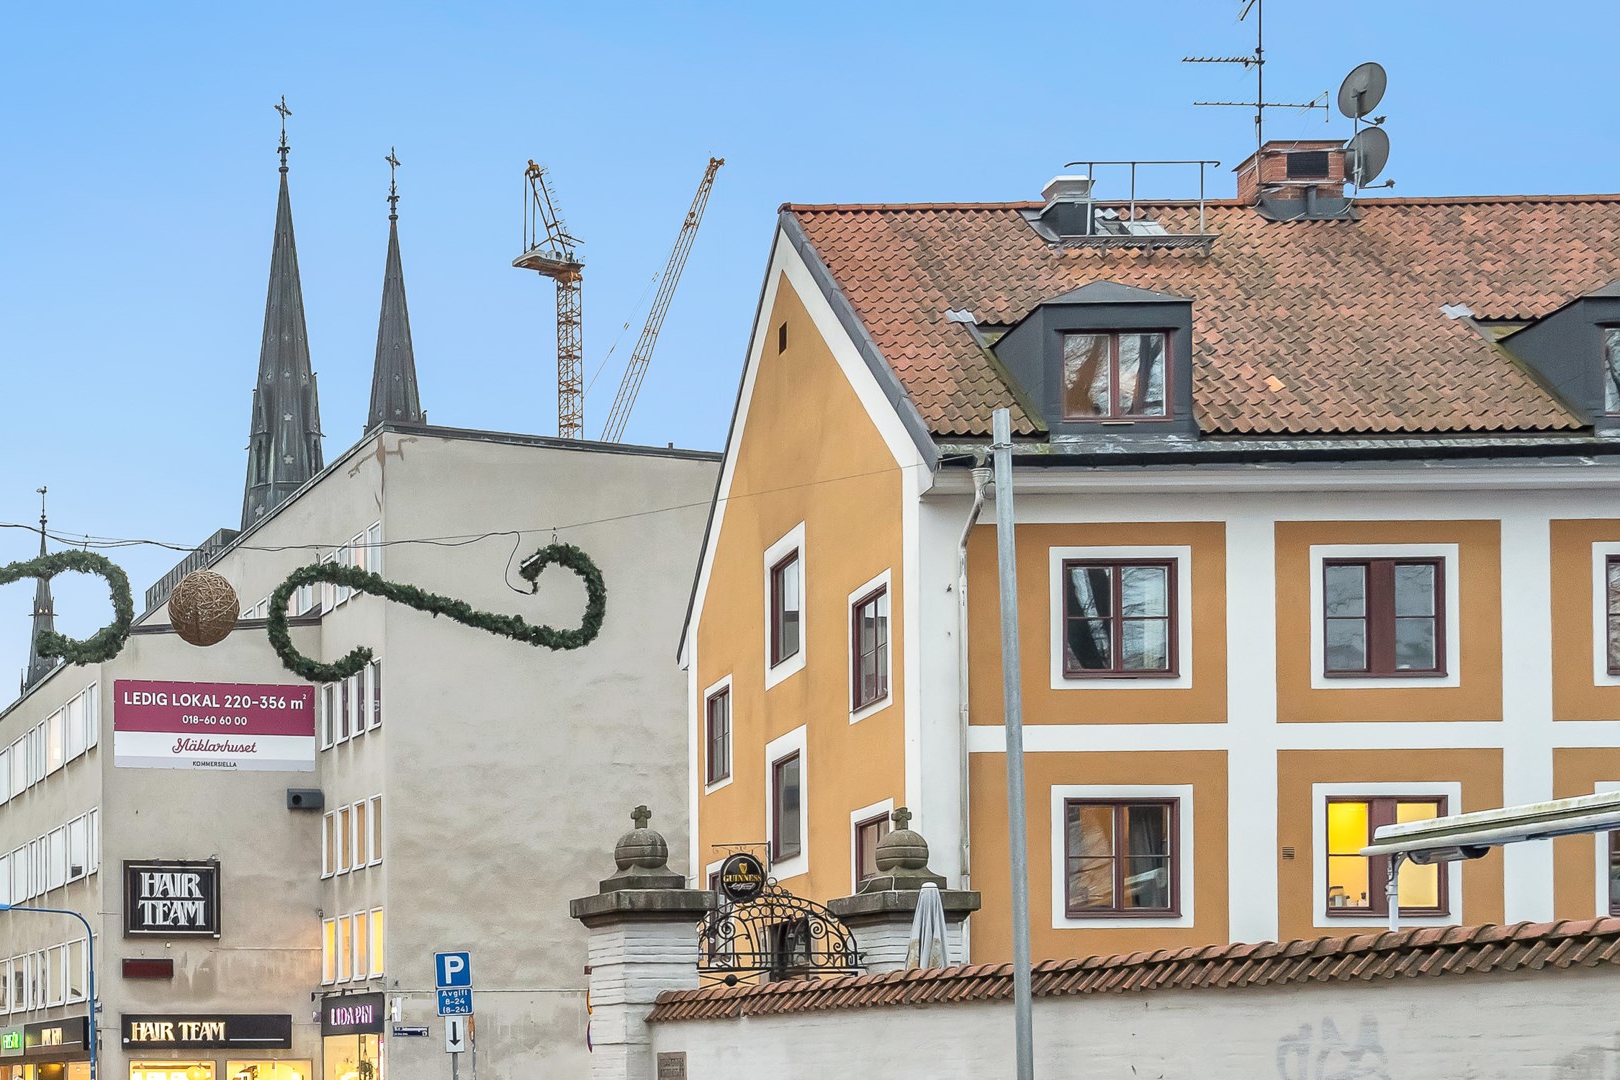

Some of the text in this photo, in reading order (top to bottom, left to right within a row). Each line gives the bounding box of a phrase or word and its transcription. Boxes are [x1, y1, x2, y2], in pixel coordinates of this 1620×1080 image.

[124, 691, 168, 706] LEDIG
[172, 693, 220, 709] LOKAL
[224, 695, 286, 710] 220-356
[182, 715, 247, 726] 018-60 60 00
[172, 737, 257, 754] Mäklarhuset
[192, 760, 237, 768] KOMMERSIELLA
[140, 872, 204, 898] HAIR
[723, 874, 762, 882] GUINNESS
[138, 899, 206, 926] TEAM
[444, 955, 465, 984] P
[442, 989, 468, 998] Avgift
[131, 1021, 225, 1042] HAIR TEAM
